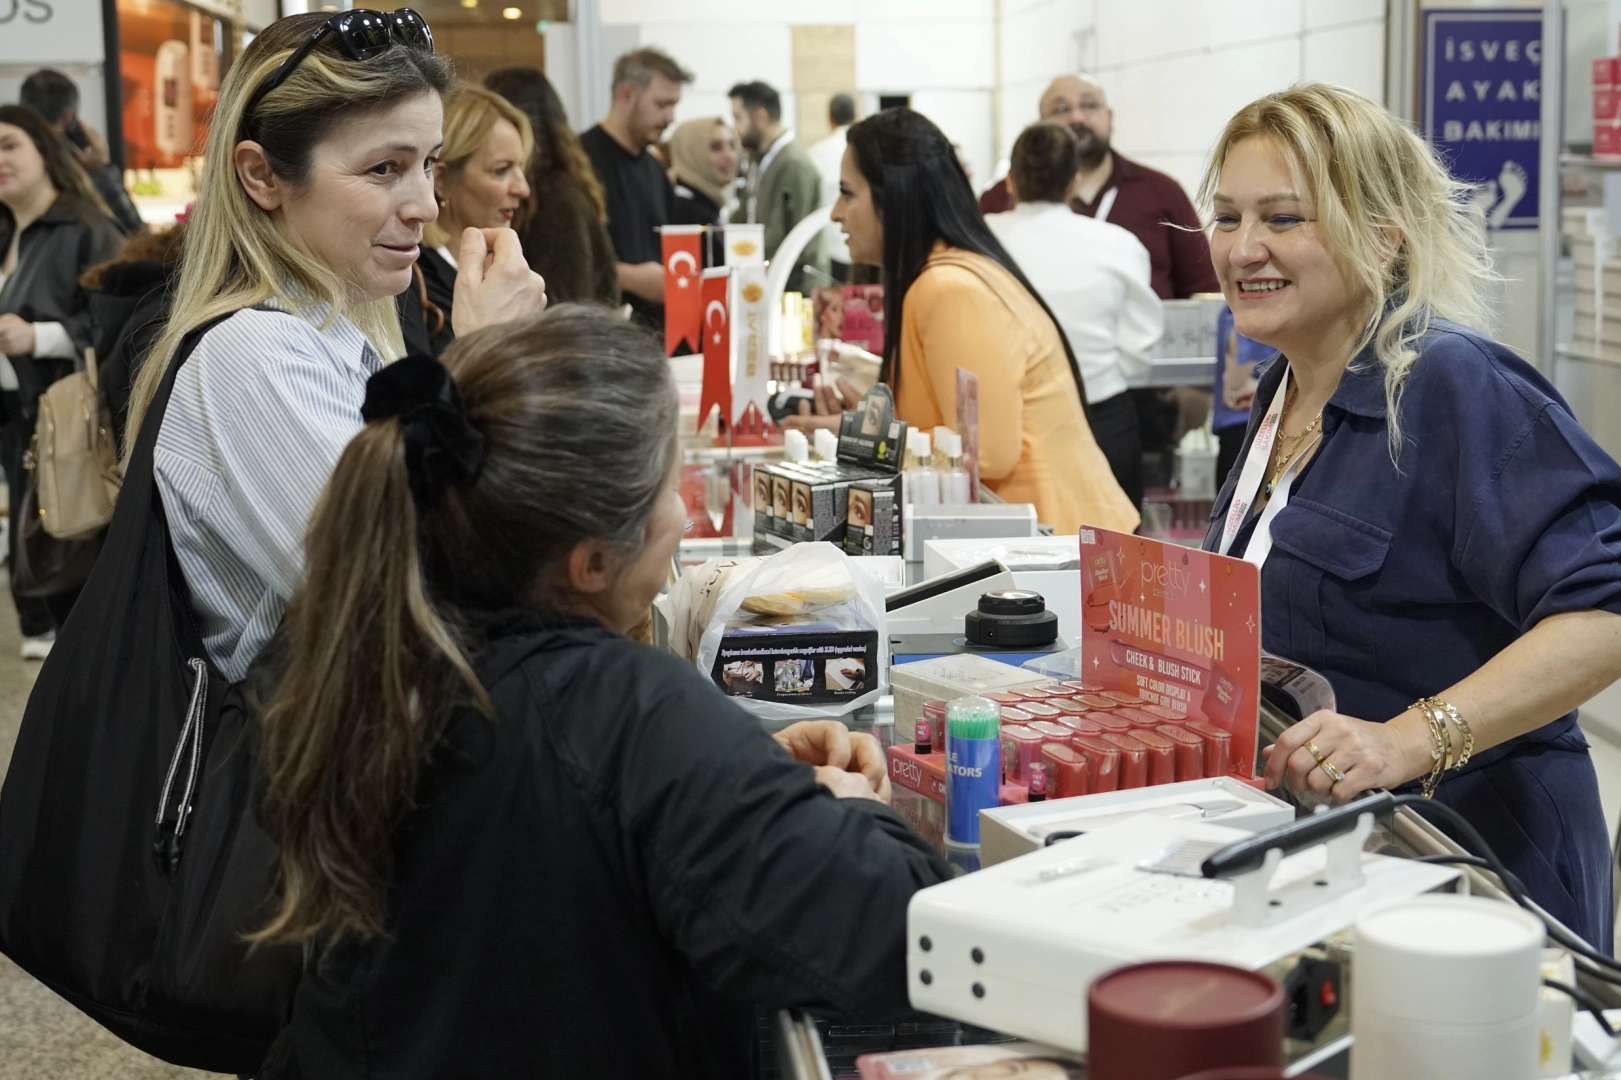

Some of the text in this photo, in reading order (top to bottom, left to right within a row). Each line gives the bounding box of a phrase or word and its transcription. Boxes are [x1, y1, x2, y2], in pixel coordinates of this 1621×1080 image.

[1445, 80, 1541, 101] AYAK
[1140, 559, 1191, 598] pretty
[1108, 599, 1171, 646] SUMMER
[1126, 649, 1202, 685] CHEEK & BLUSH STICK
[1136, 674, 1149, 688] SOFT
[1149, 678, 1165, 693] COLOR
[1165, 683, 1187, 701] DISPLAY
[1171, 699, 1188, 714] BLUSH
[892, 757, 922, 788] pretty
